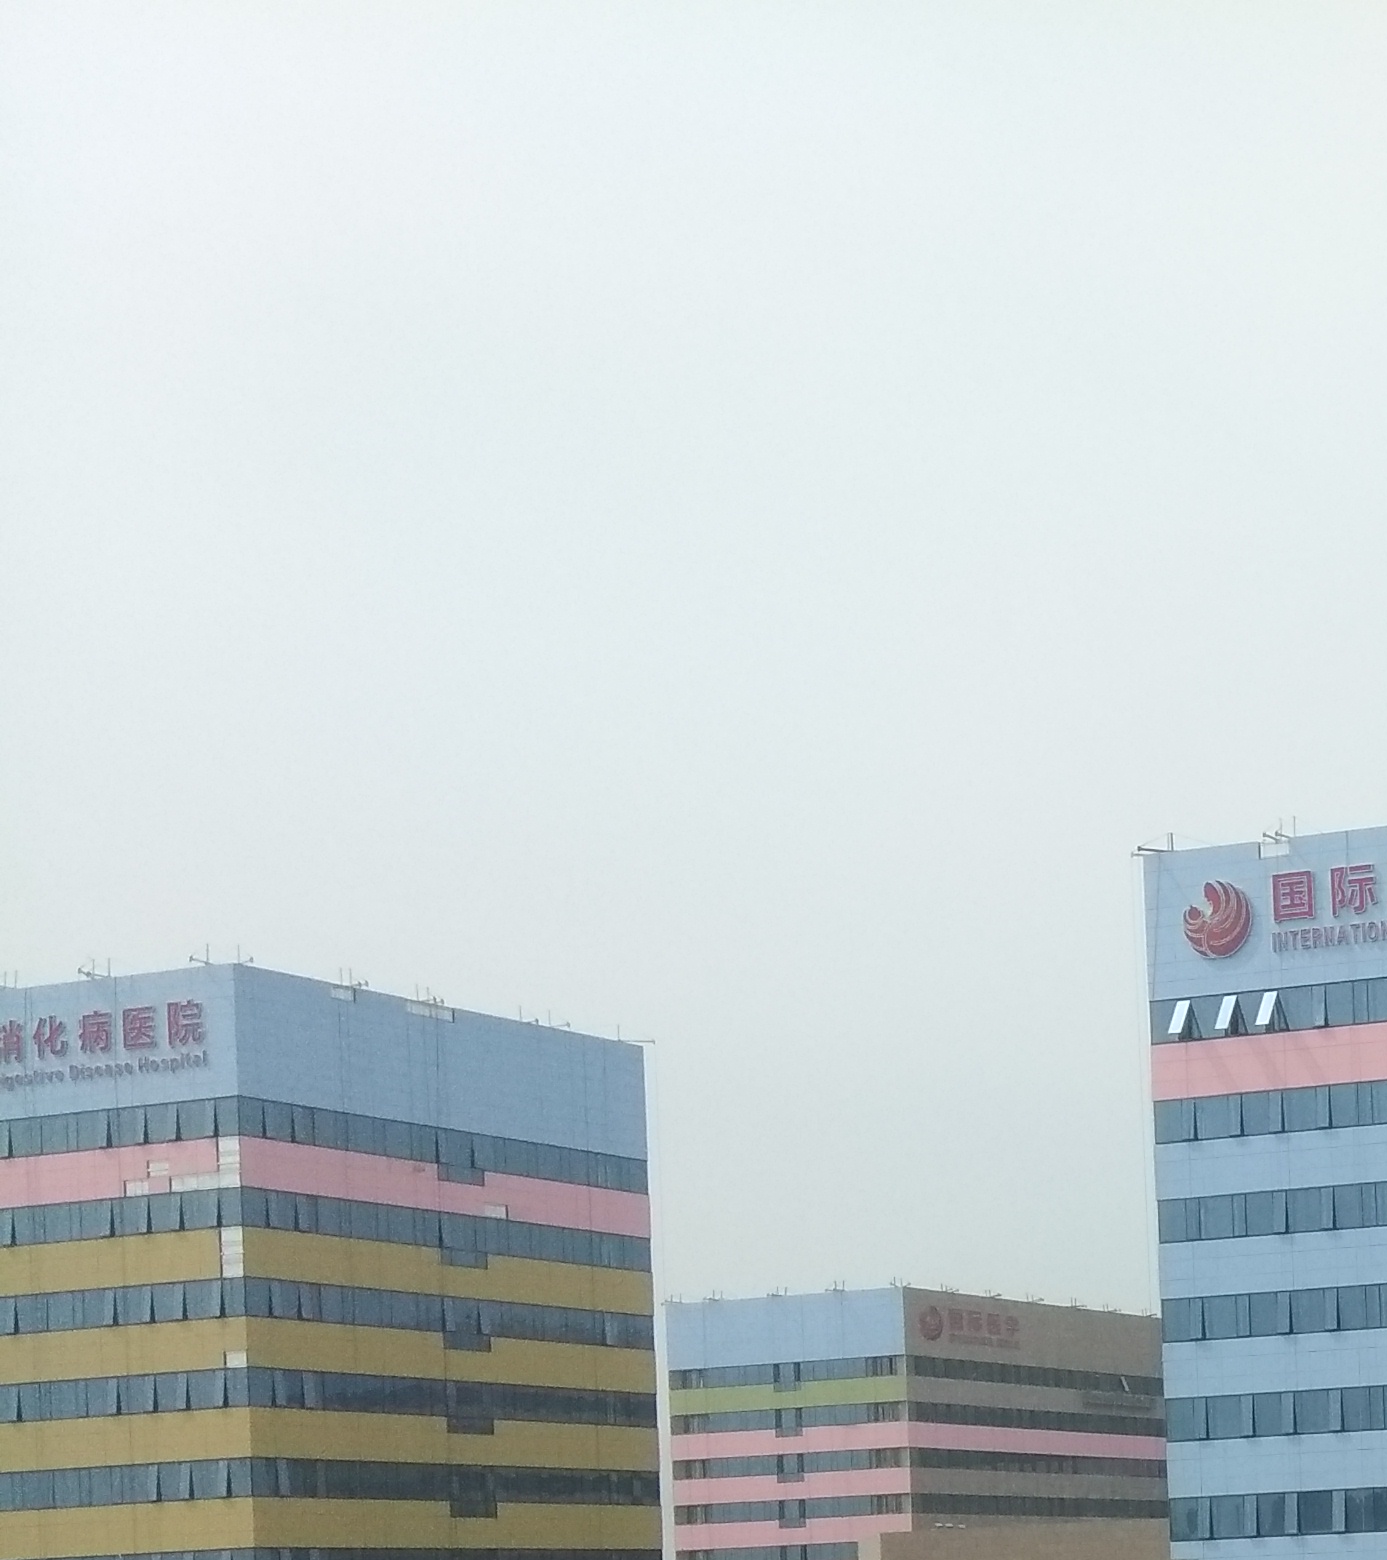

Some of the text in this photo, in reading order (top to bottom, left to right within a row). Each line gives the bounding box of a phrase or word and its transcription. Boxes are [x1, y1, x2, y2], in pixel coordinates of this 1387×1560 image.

[0, 998, 206, 1065] 消化病医院
[138, 1049, 208, 1075] Hospital
